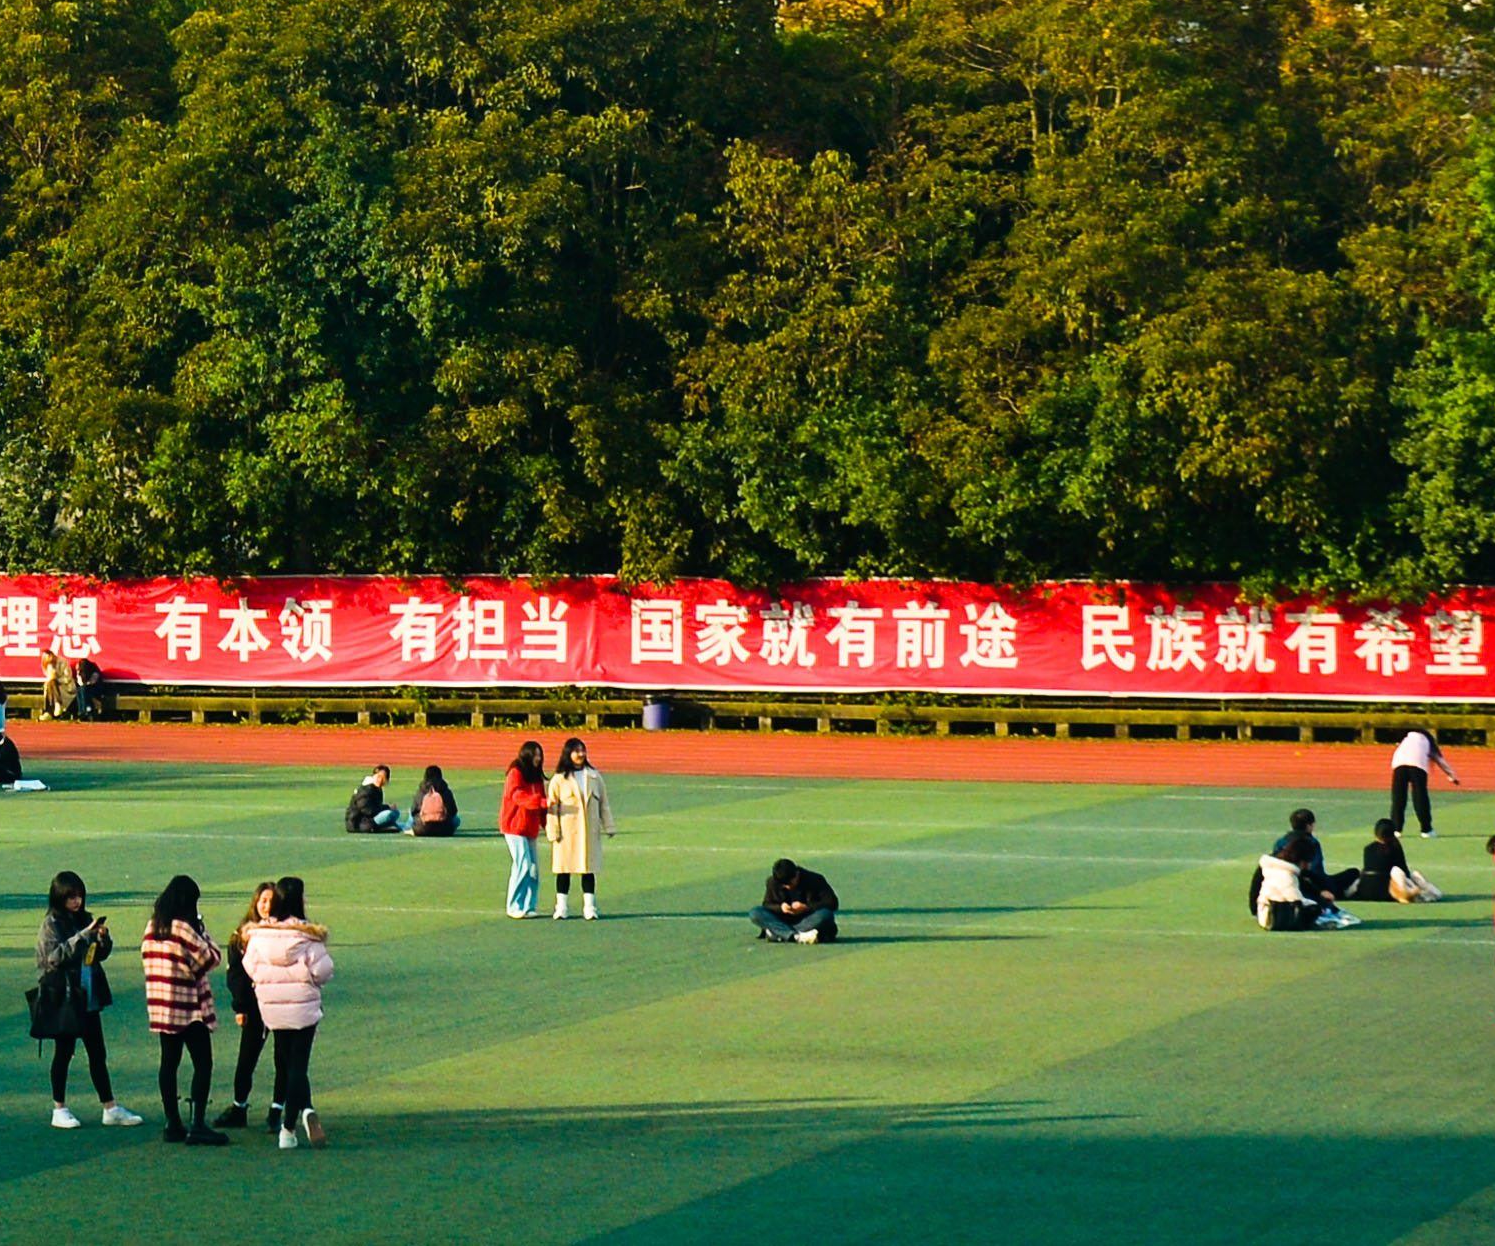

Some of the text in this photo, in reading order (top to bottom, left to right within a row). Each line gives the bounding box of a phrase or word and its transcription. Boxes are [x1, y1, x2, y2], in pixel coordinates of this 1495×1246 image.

[155, 595, 333, 662] 有本领
[389, 597, 568, 662] 有担当
[630, 599, 1019, 670] 国家就有前途
[1081, 605, 1486, 676] 民族就有希望
